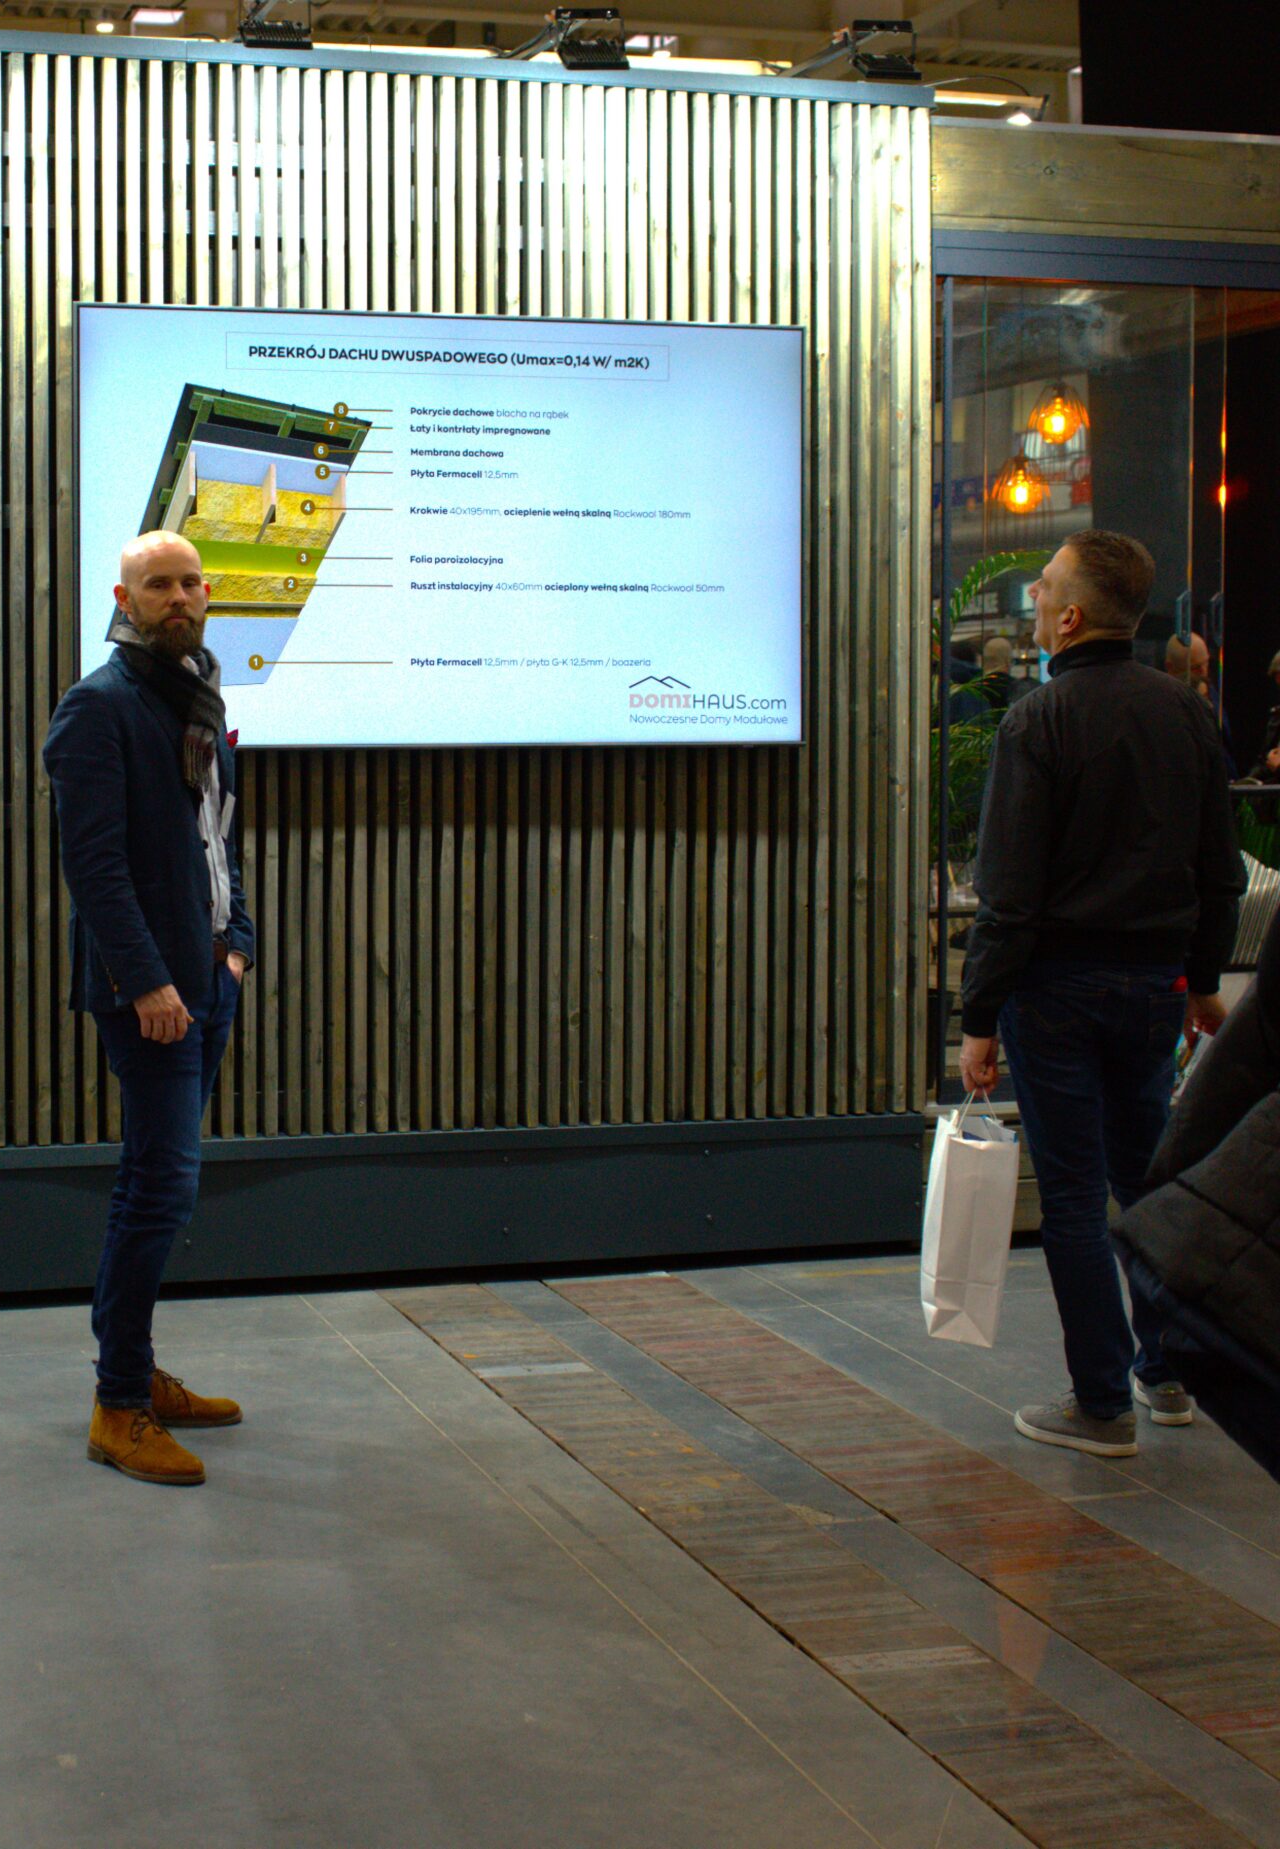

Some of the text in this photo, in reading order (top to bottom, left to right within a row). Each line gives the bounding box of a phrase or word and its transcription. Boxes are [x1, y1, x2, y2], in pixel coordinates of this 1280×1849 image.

[248, 344, 325, 359] PRZEKRÓJ
[328, 348, 378, 361] DACHU
[381, 350, 508, 365] DWUSPADOWEGO
[511, 354, 590, 368] (Umax=0,14
[614, 356, 650, 370] m2K)
[338, 405, 345, 415] 8
[410, 406, 451, 418] Pokrycie
[453, 408, 494, 417] dachowe
[496, 408, 528, 418] blacha
[542, 410, 569, 420] rąbek
[328, 421, 335, 431] 7
[410, 424, 431, 434] Łaty
[437, 424, 481, 436] kontrłaty
[482, 426, 551, 436] impregnowane
[317, 445, 324, 455] 6
[410, 448, 504, 458] Membrana dachowa
[319, 466, 326, 476] 5
[410, 470, 435, 480] Płyta
[436, 470, 482, 479] Fermacell
[304, 502, 311, 512] 4
[410, 506, 448, 515] Krokwie
[504, 508, 551, 518] ocieplenie
[552, 508, 580, 518] wełną
[581, 509, 612, 519] skalną
[614, 510, 656, 518] Rockwool
[658, 510, 691, 519] 180mm
[300, 553, 307, 562] 3
[410, 556, 504, 566] Folia paroizolacyjna
[288, 578, 294, 588] 2
[410, 582, 436, 590] Ruszt
[438, 581, 494, 592] instalacyjny
[544, 582, 589, 593] ocieplony
[590, 583, 618, 592] wełną
[620, 583, 649, 593] skalną
[650, 584, 694, 592] Rockwool
[696, 584, 725, 593] 50mm
[410, 658, 435, 668] Płyta
[436, 658, 482, 666] Fermacell
[526, 658, 550, 668] płyta
[552, 658, 568, 667] G-K
[612, 658, 652, 667] boazeria
[629, 714, 788, 726] Nowoczesne Domy Modułowe
